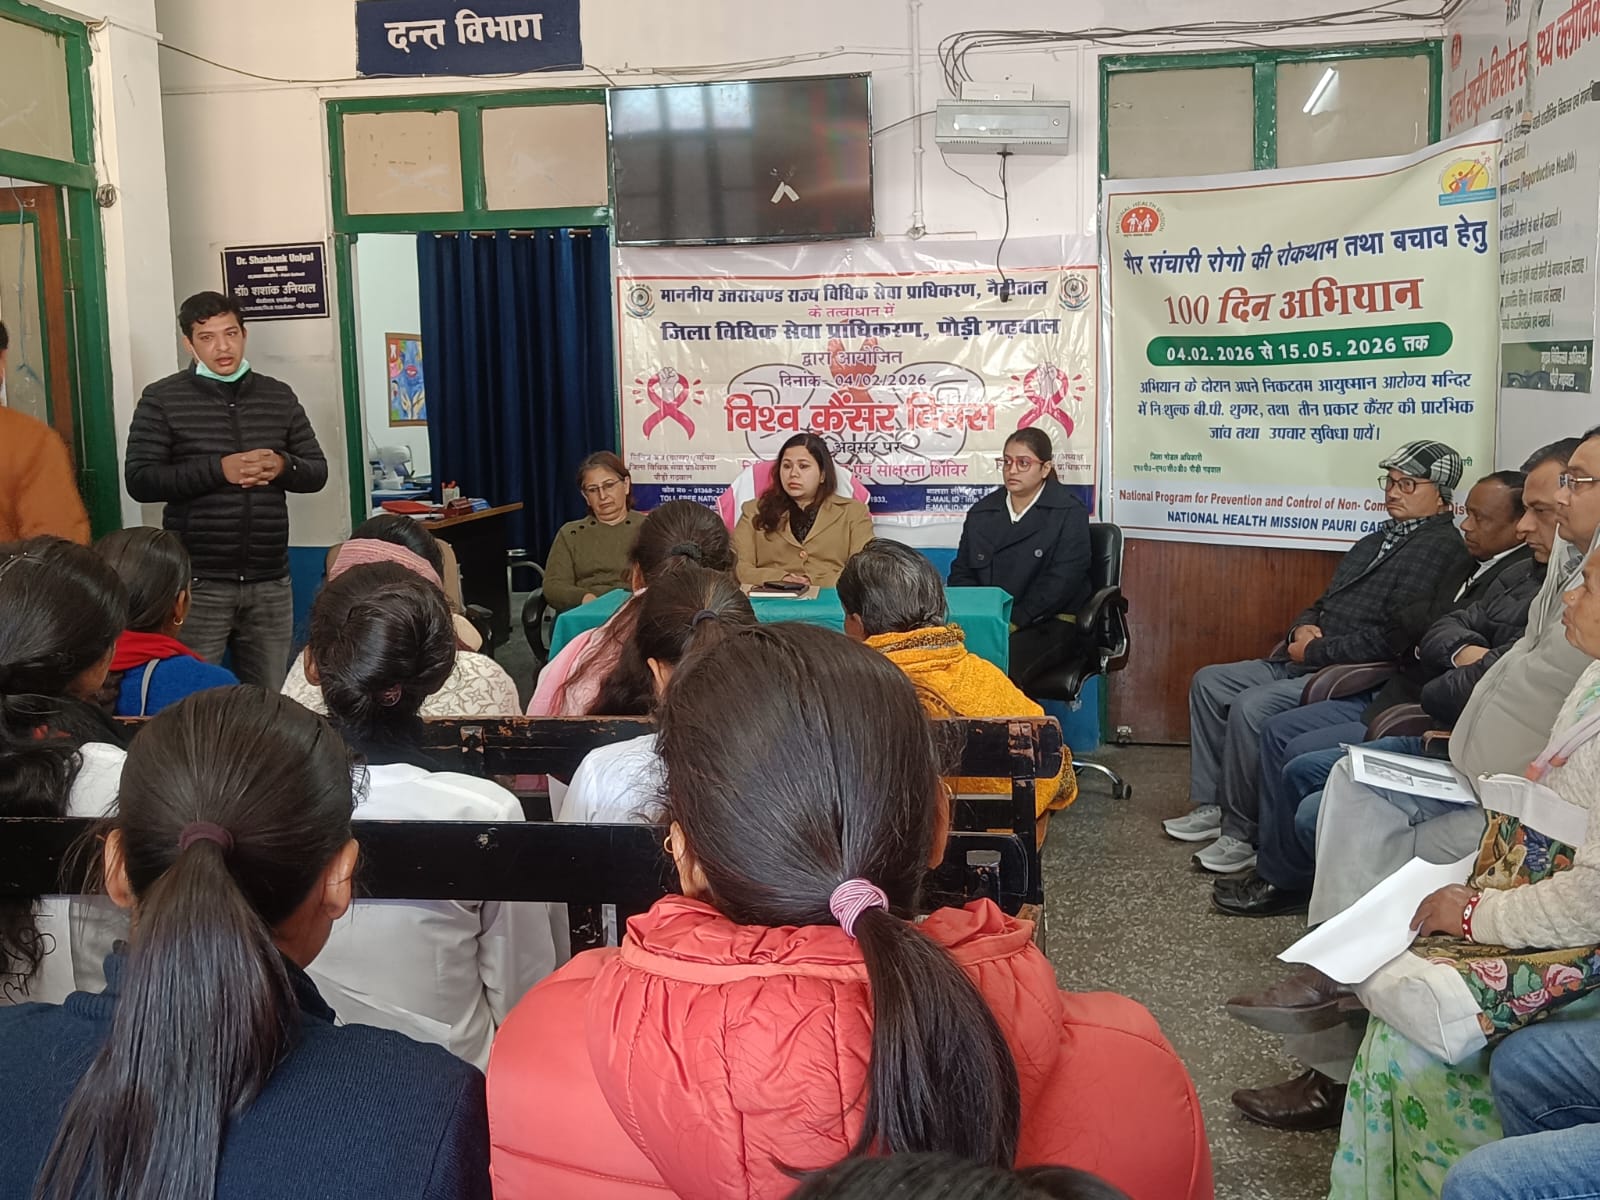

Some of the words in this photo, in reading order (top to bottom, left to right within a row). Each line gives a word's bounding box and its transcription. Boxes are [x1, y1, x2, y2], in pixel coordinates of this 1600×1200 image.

[384, 20, 446, 53] दन्त
[455, 9, 543, 44] विभाग
[1489, 37, 1518, 104] किशोर
[1124, 250, 1143, 275] गैर
[1149, 247, 1201, 274] संचारी
[1251, 244, 1273, 271] की
[1277, 240, 1339, 267] रोकथाम
[1344, 232, 1384, 257] तथा
[1391, 225, 1449, 252] बचाव
[1455, 214, 1488, 254] हेतु
[660, 286, 714, 303] माननीय
[718, 289, 784, 303] उत्तराखण्ड
[787, 288, 819, 302] राज्य
[824, 284, 869, 301] विधिक
[874, 282, 902, 300] सेवा
[906, 282, 982, 300] प्राधिकरण,
[1164, 294, 1210, 326] 100
[1218, 286, 1276, 324] दिन
[1279, 276, 1425, 318] अभियान
[808, 306, 822, 318] के
[883, 303, 896, 317] में
[660, 321, 711, 341] जिला
[715, 320, 777, 341] विधिक
[783, 320, 822, 340] सेवा
[827, 318, 930, 341] प्राधिकरण,
[936, 316, 982, 340] पौड़ी
[802, 352, 831, 367] द्वारा
[837, 346, 903, 365] आयोजित
[1258, 341, 1274, 360] से
[1402, 334, 1430, 352] तक
[835, 374, 927, 387] 04/02/2026
[1140, 378, 1181, 394] अभियान
[1184, 376, 1197, 393] के
[1235, 377, 1260, 393] अपने
[1263, 377, 1313, 393] निकटतम
[1318, 376, 1377, 395] आयुष्मान
[1383, 371, 1427, 389] आरोग्य
[1432, 369, 1473, 388] मन्दिर
[724, 393, 801, 432] विश्व
[810, 391, 897, 432] कैंसर
[906, 392, 997, 431] दिवस
[1138, 400, 1147, 416] में
[1194, 400, 1224, 417] बी.पी.
[1229, 402, 1263, 420] शुगर,
[1268, 403, 1290, 417] तथा
[1298, 400, 1320, 417] तीन
[1323, 402, 1359, 417] प्रकार
[1363, 398, 1394, 416] कैंसर
[1398, 398, 1416, 415] की
[1421, 396, 1475, 415] प्रारंभिक
[1209, 425, 1232, 440] जांच
[1236, 427, 1260, 440] तथा
[1269, 427, 1306, 440] उपचार
[1310, 423, 1349, 444] सुविधा
[882, 442, 902, 452] पर
[877, 463, 926, 477] साक्षरता
[930, 460, 968, 477] शिविर
[925, 495, 950, 503] E-MAIL
[1119, 489, 1154, 501] National
[1155, 491, 1192, 506] Program
[1195, 492, 1209, 504] for
[1211, 493, 1262, 506] Prevention
[1265, 496, 1284, 507] and
[1286, 496, 1322, 509] Control
[1325, 498, 1335, 510] of
[1337, 499, 1361, 511] Non-
[1167, 511, 1219, 525] NATIONAL
[1222, 513, 1267, 528] HEALTH
[1270, 517, 1319, 530] MISSION
[1321, 518, 1357, 533] PAURI
